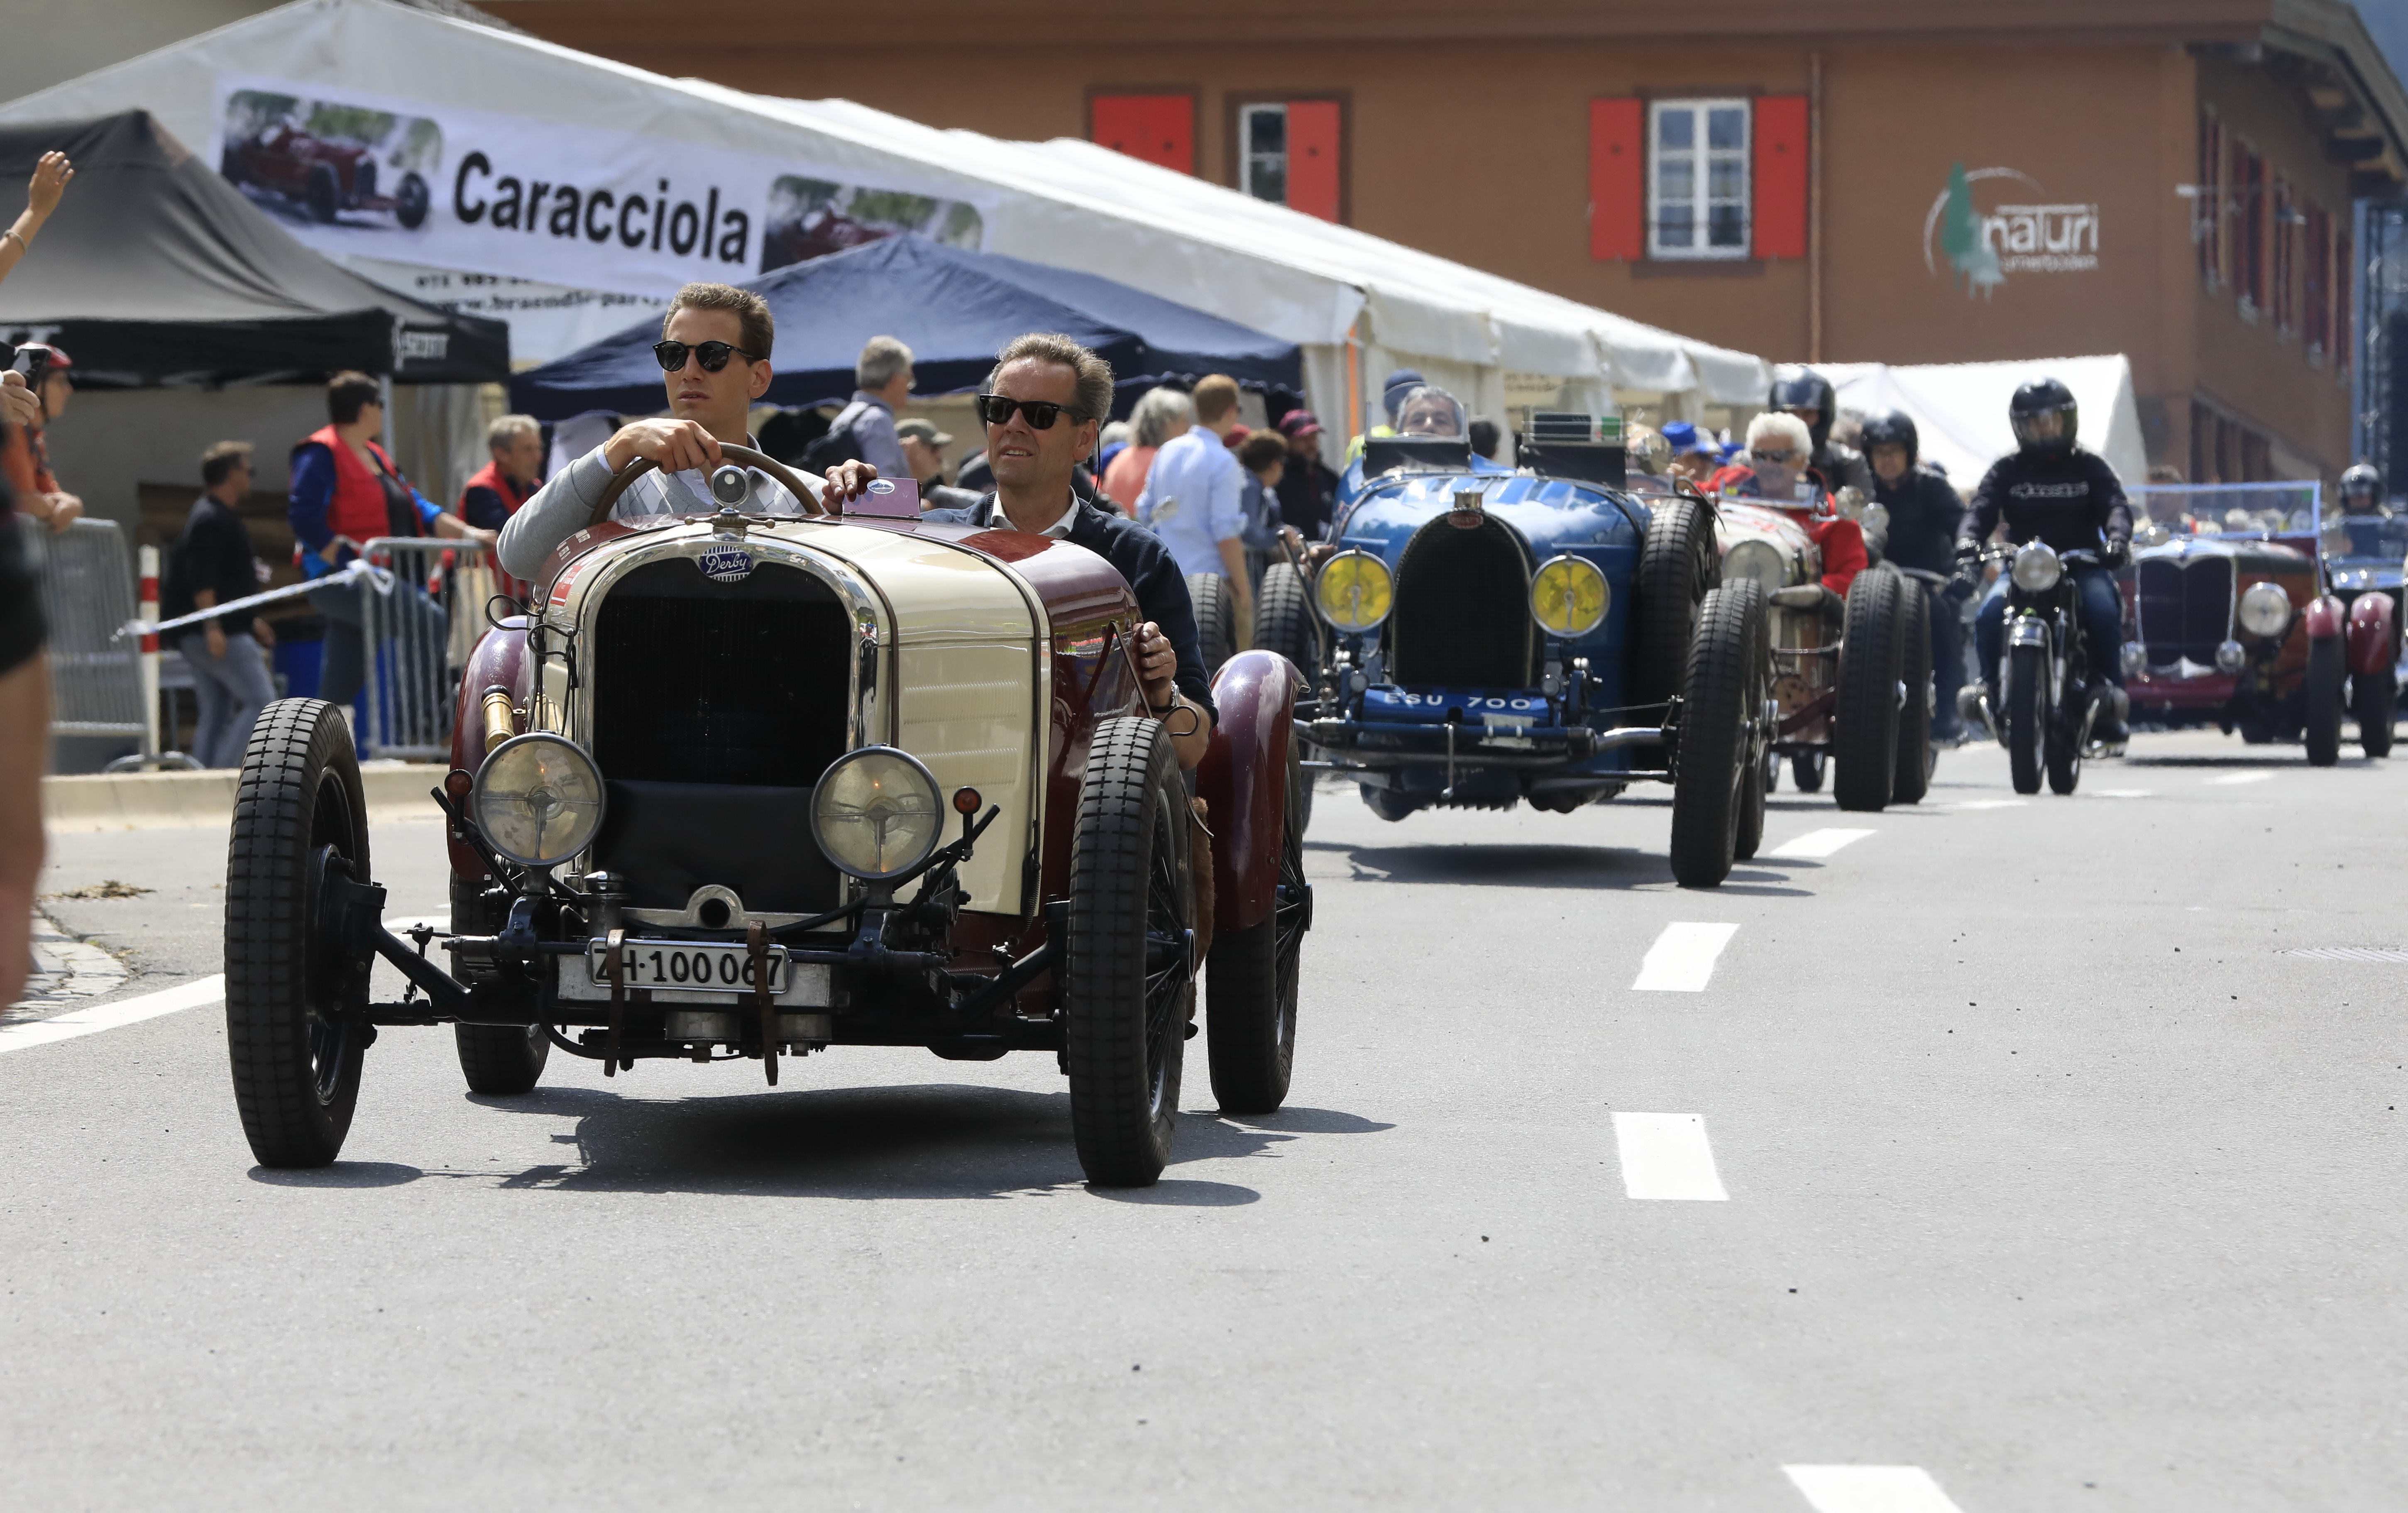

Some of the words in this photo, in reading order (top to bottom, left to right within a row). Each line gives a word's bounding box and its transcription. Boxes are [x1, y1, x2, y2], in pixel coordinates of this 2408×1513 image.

[453, 151, 749, 265] Caracciola
[706, 552, 747, 576] Derby
[1384, 692, 1443, 706] ESU
[1467, 697, 1531, 710] 700
